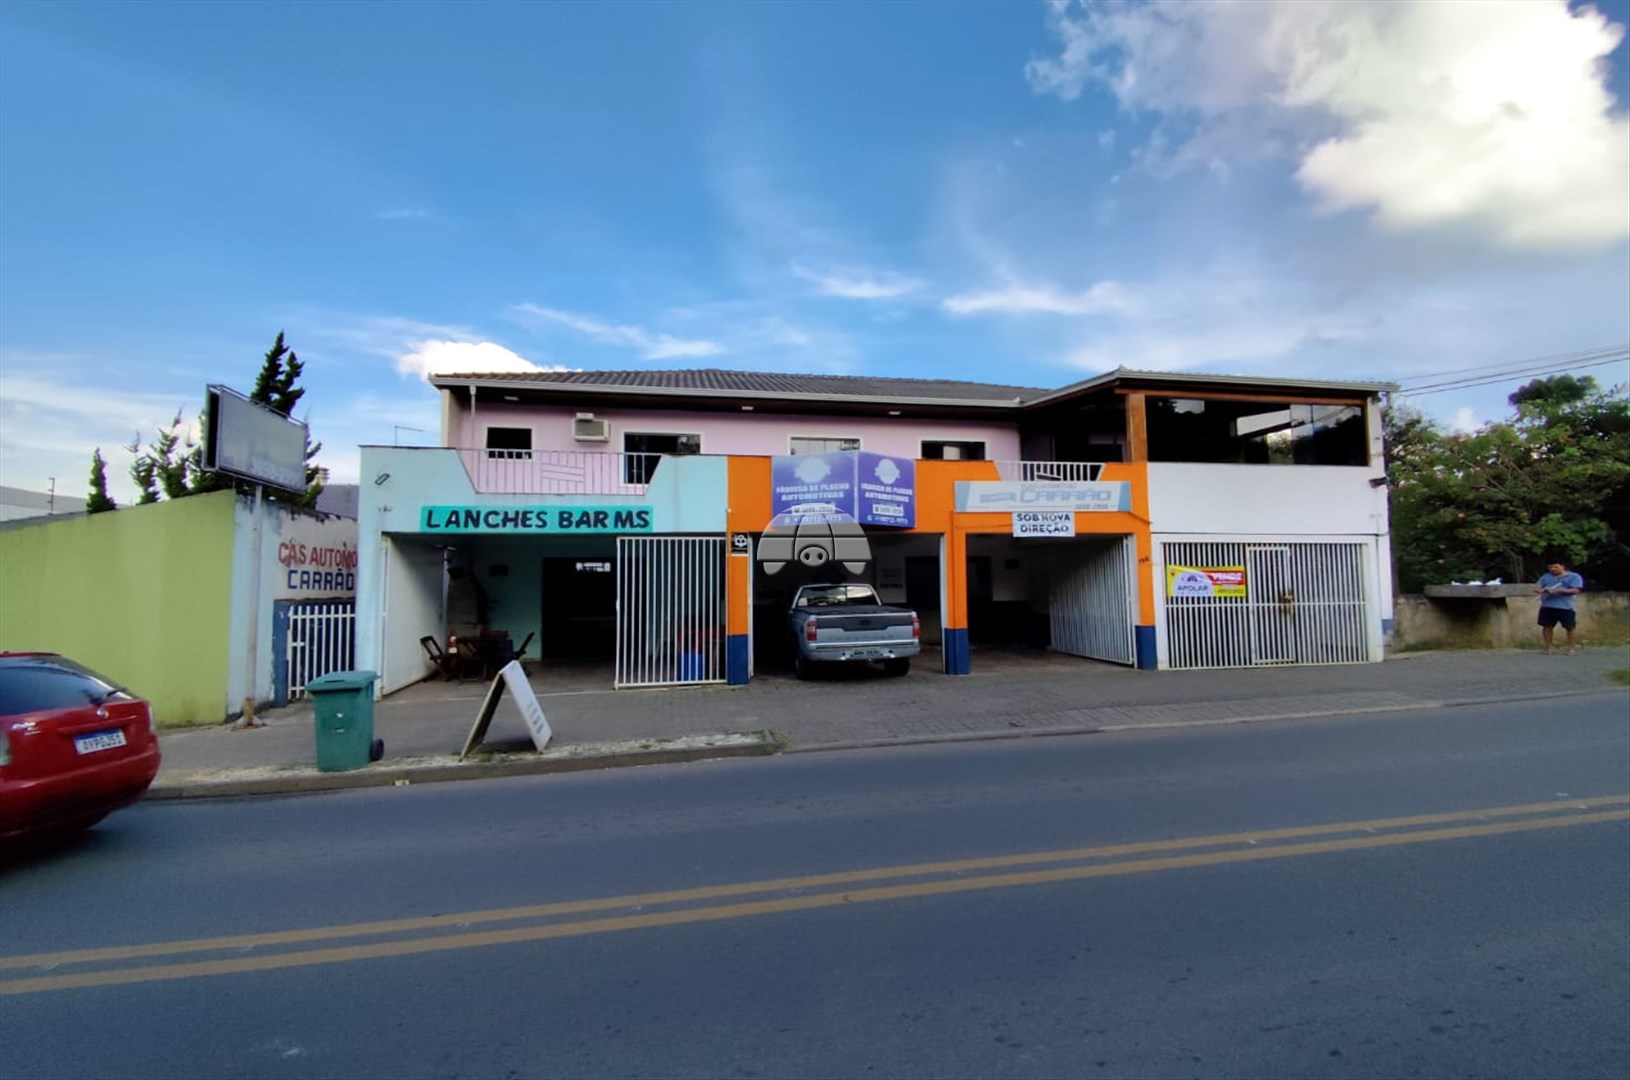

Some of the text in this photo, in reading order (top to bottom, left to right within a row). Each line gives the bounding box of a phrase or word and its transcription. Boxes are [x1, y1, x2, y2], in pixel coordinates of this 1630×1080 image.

[426, 509, 650, 529] LANCHES BAR MS
[1016, 513, 1071, 522] SOB NOVA
[1020, 522, 1069, 533] DIREÇÃO
[287, 568, 355, 591] CARRÃO
